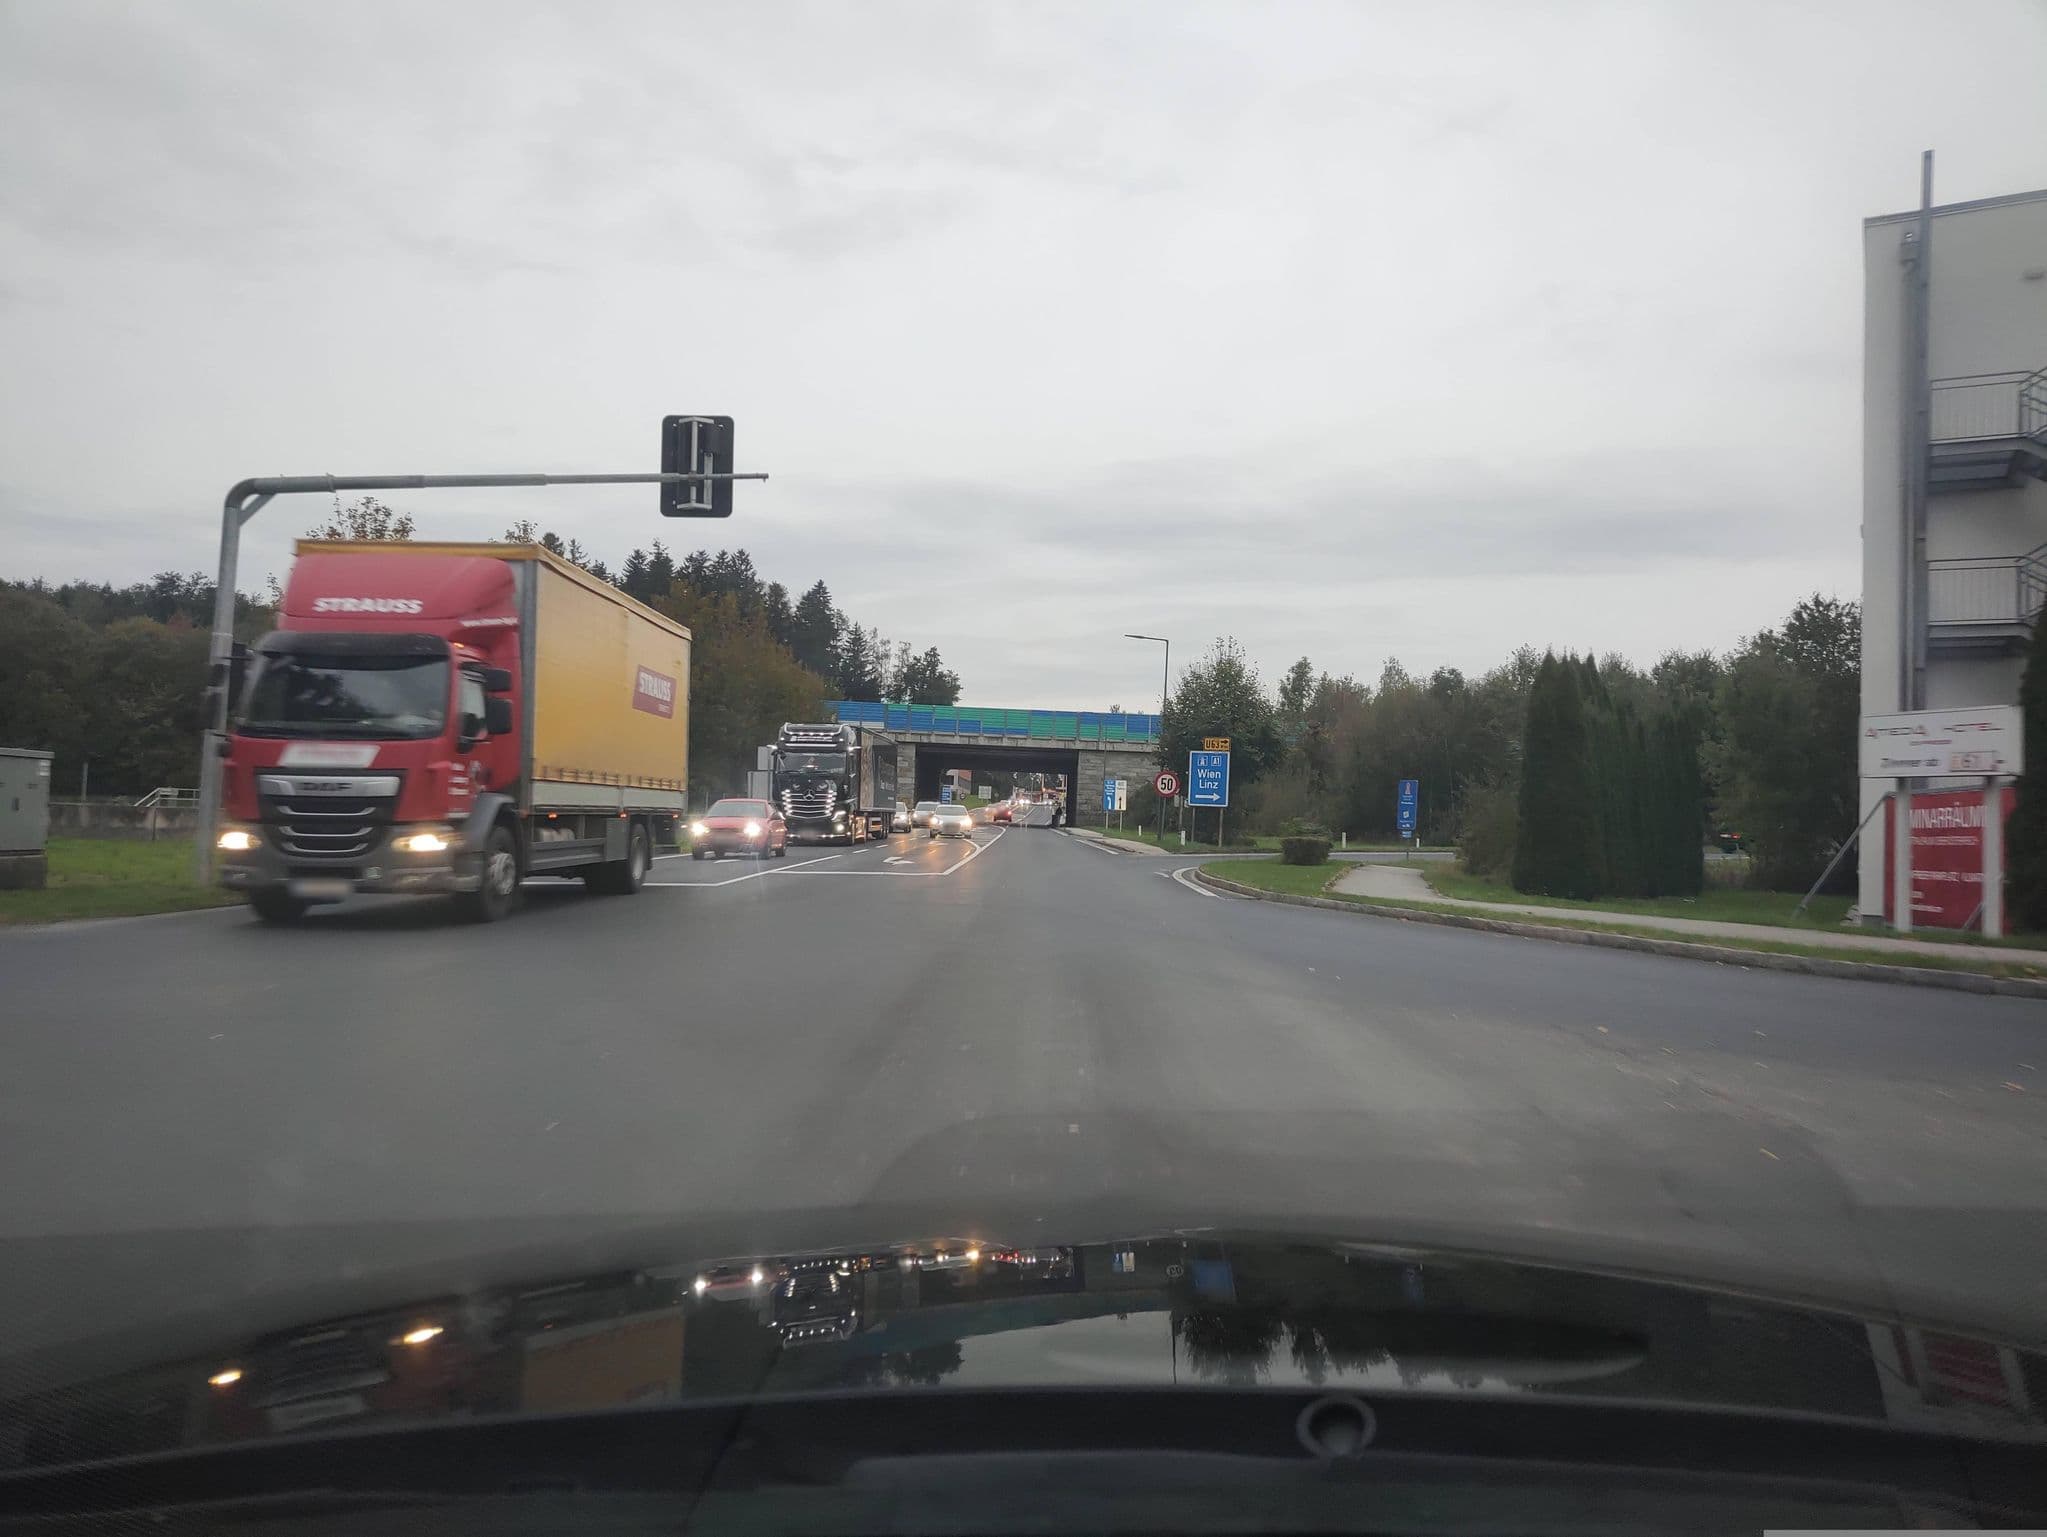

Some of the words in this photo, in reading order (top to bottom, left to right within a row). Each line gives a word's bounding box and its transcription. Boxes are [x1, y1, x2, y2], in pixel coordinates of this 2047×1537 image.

[313, 598, 424, 614] STRAUSS
[639, 671, 671, 702] STRAUSS
[1197, 769, 1221, 779] Wien
[1160, 778, 1173, 791] 50
[1199, 779, 1219, 789] Linz
